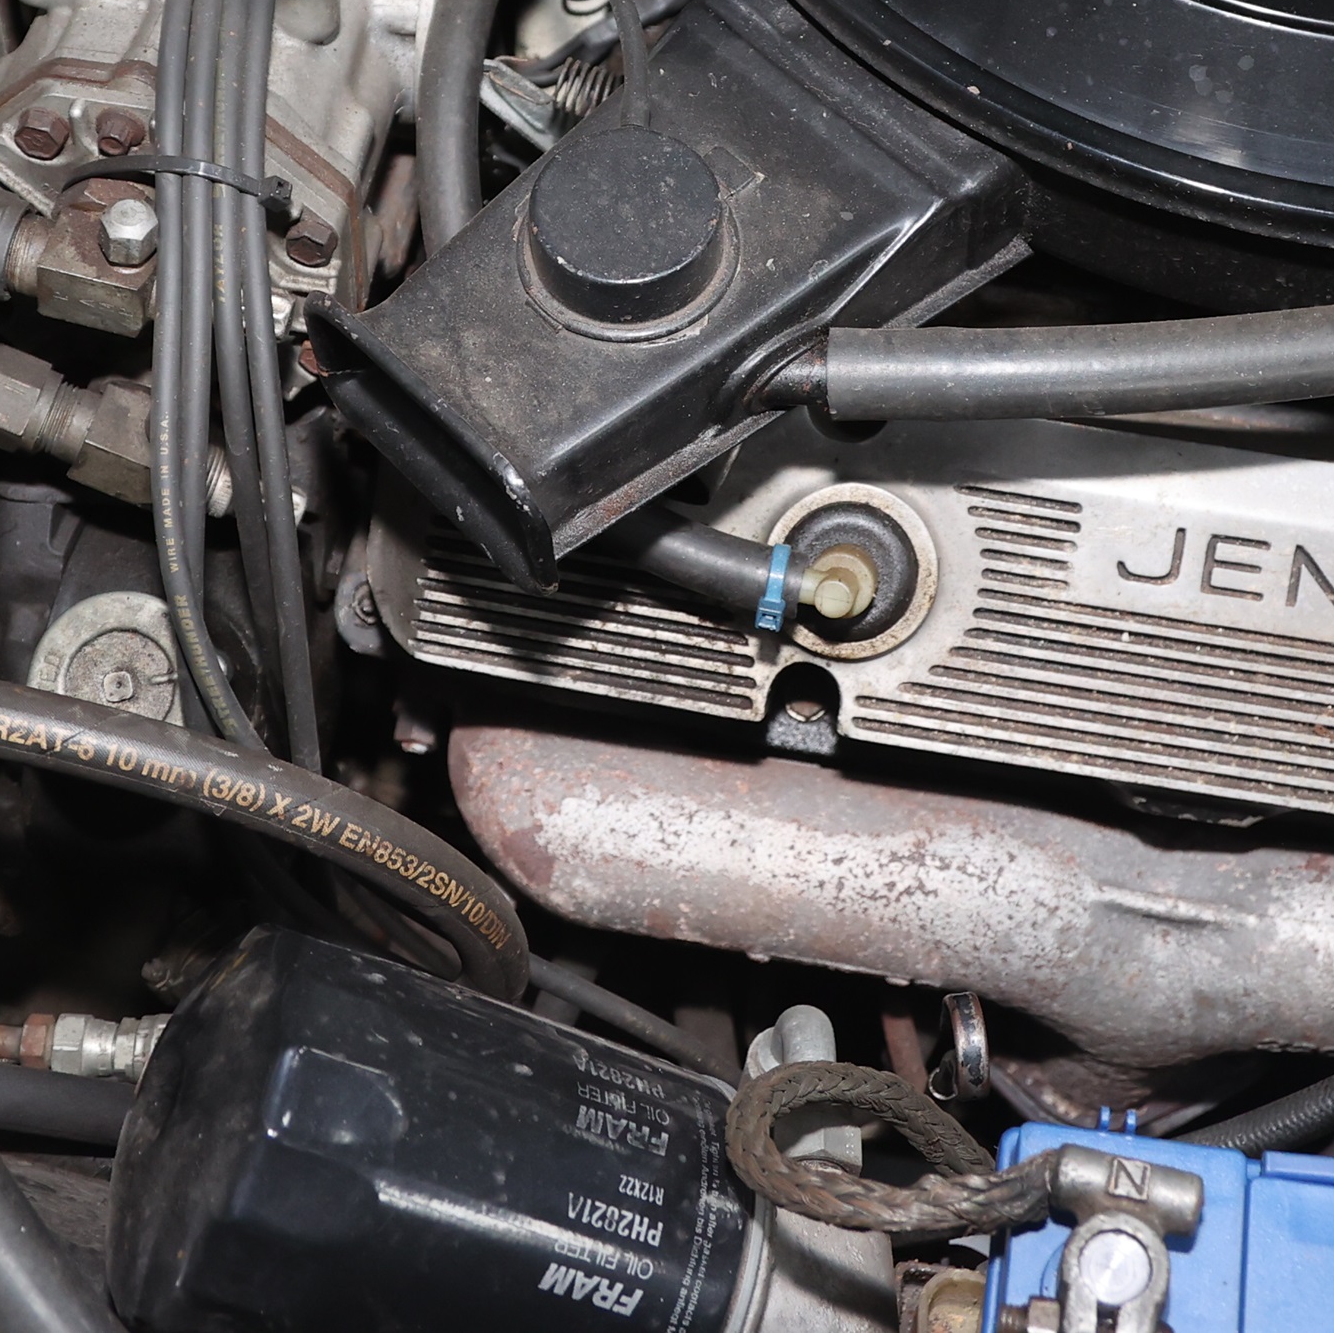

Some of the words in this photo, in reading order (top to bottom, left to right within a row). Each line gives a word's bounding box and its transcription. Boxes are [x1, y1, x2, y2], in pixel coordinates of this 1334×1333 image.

[160, 464, 169, 481] IN
[163, 489, 173, 528] MADE
[166, 537, 179, 573] WIRE
[105, 742, 138, 772] 10
[142, 757, 197, 791] mm
[202, 767, 265, 812] (3/8)
[268, 792, 294, 820] X
[292, 803, 342, 837] 2W
[338, 821, 513, 950] EN853/2SN/10/DIN
[573, 1053, 666, 1099] PH2821A
[577, 1081, 636, 1114] FILTER
[639, 1103, 670, 1126] OIL
[575, 1104, 670, 1157] FRAM
[619, 1174, 665, 1206] R12X22
[567, 1192, 664, 1247] PH2821A
[554, 1240, 622, 1270] FILTER
[624, 1252, 654, 1280] OIL
[537, 1262, 644, 1317] FRAM
